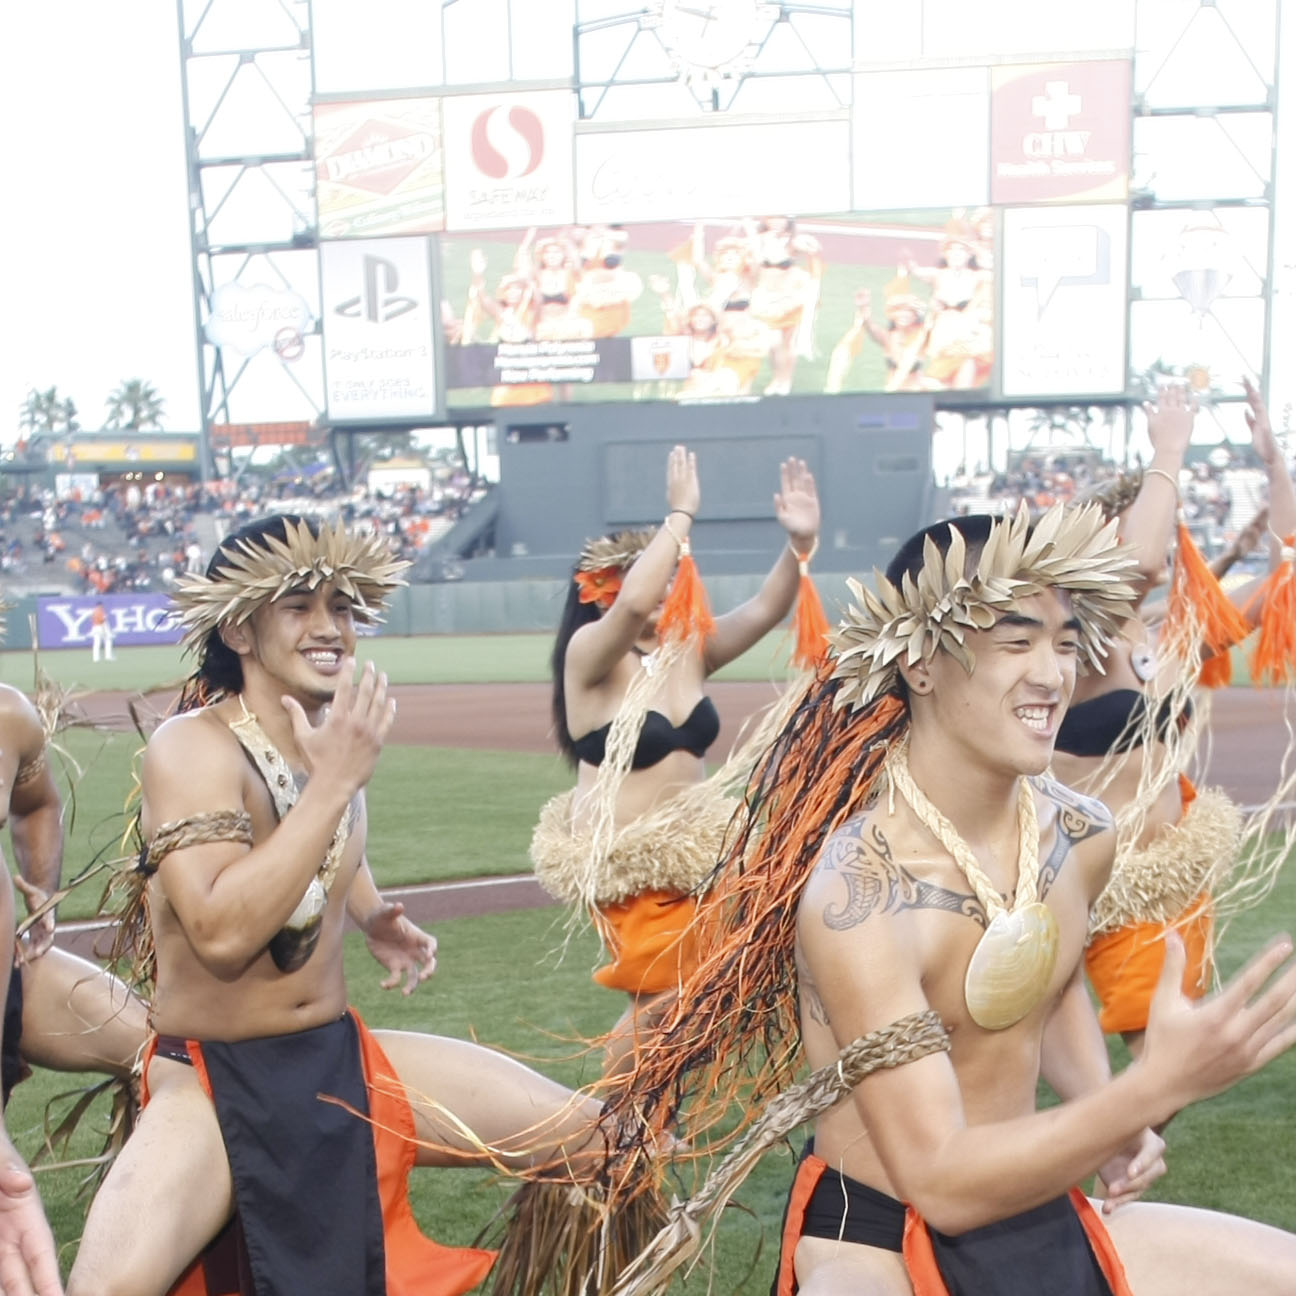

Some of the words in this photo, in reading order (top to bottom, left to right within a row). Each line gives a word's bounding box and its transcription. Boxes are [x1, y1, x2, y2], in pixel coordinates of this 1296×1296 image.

[1024, 130, 1092, 158] CHW
[470, 185, 551, 206] SAFEWAY
[45, 603, 186, 643] YHO
